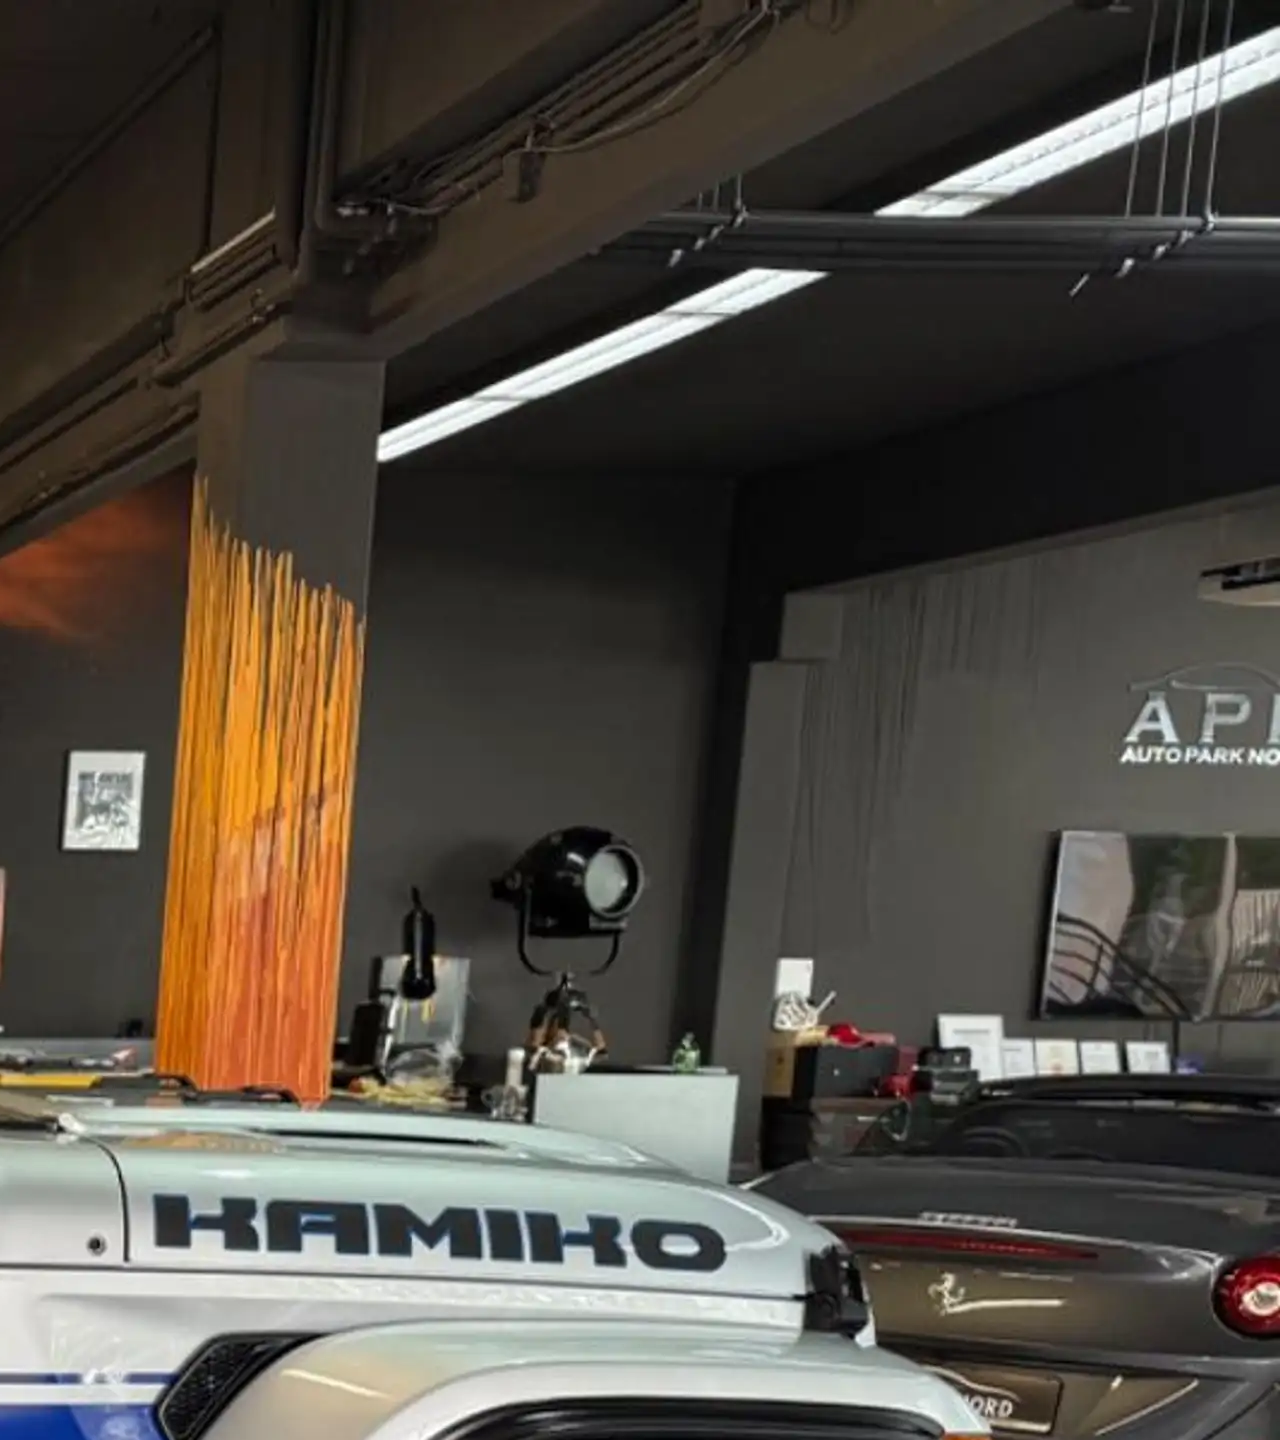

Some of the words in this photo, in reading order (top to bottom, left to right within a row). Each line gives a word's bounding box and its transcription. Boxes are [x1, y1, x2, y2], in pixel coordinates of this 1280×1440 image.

[1119, 746, 1182, 764] AUTO
[1184, 746, 1245, 764] PARK
[153, 1193, 728, 1273] KAMIKO
[965, 1395, 1013, 1418] ORD
